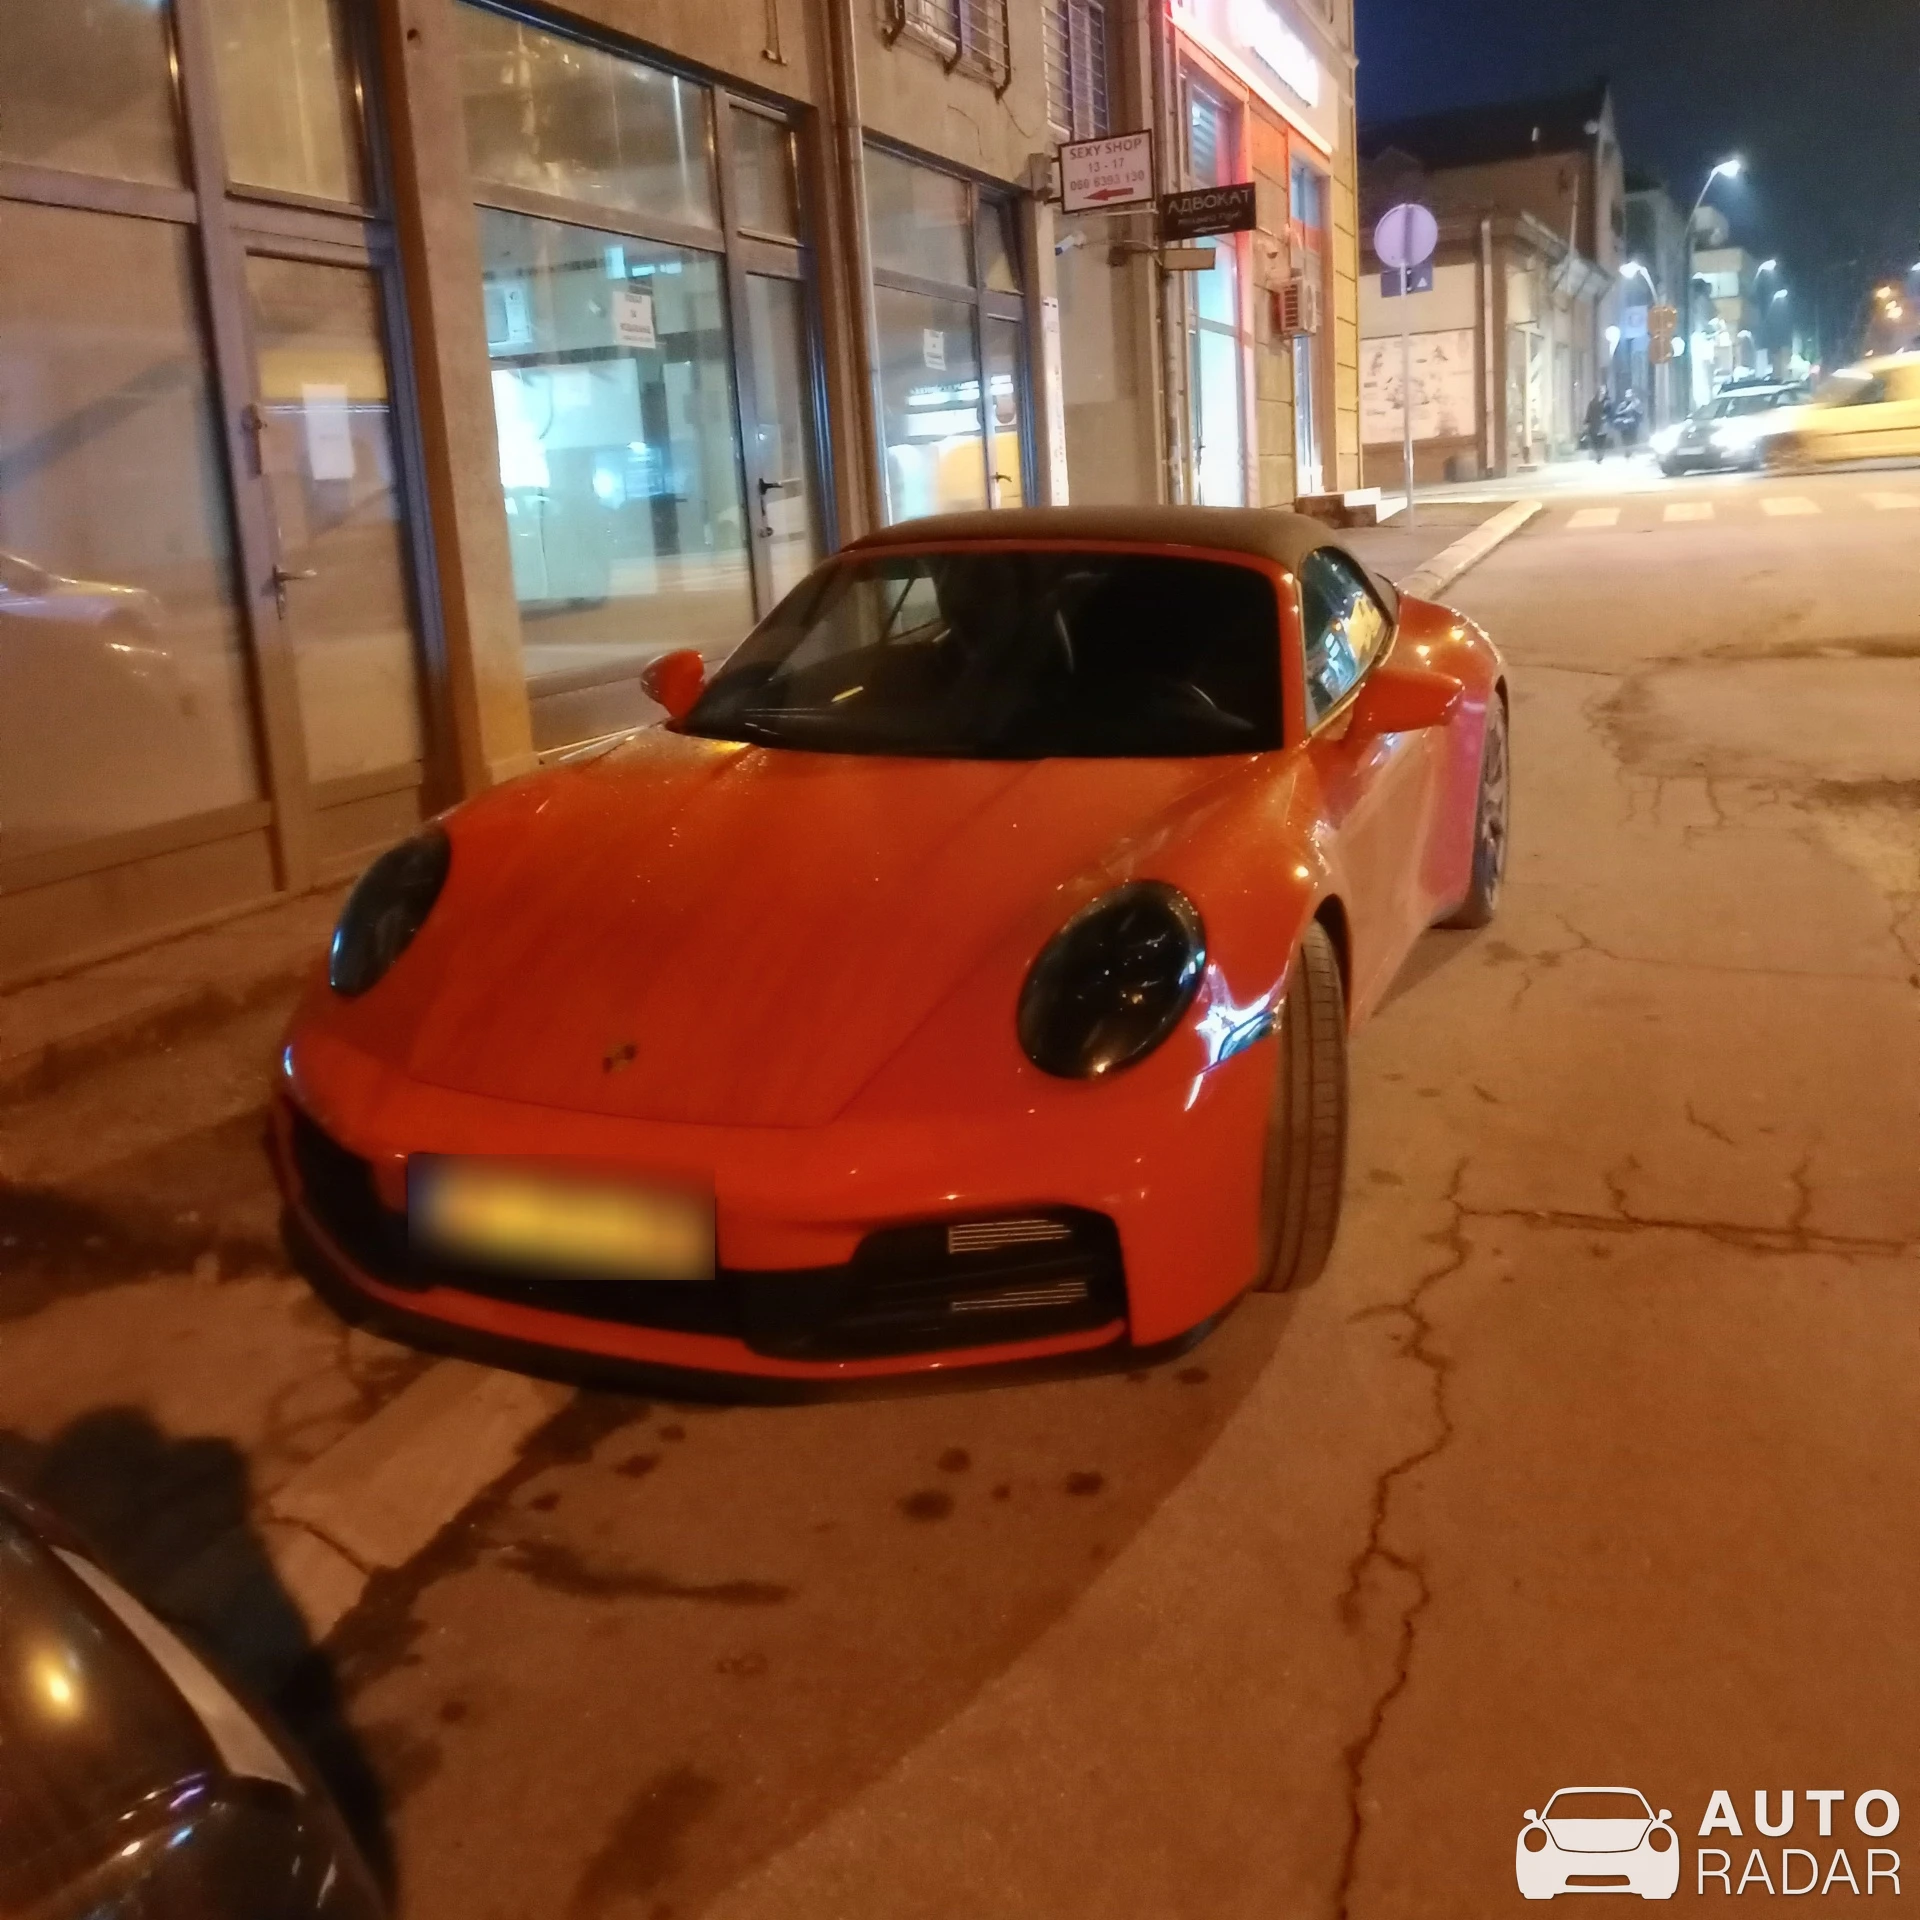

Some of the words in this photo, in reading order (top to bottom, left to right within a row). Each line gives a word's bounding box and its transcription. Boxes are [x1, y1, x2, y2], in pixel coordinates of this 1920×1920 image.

[1069, 144, 1101, 160] SEXY
[1105, 138, 1142, 154] SHOP
[1088, 161, 1101, 173] 13
[1112, 157, 1125, 168] 17
[1168, 188, 1252, 215] АДВОКАТ
